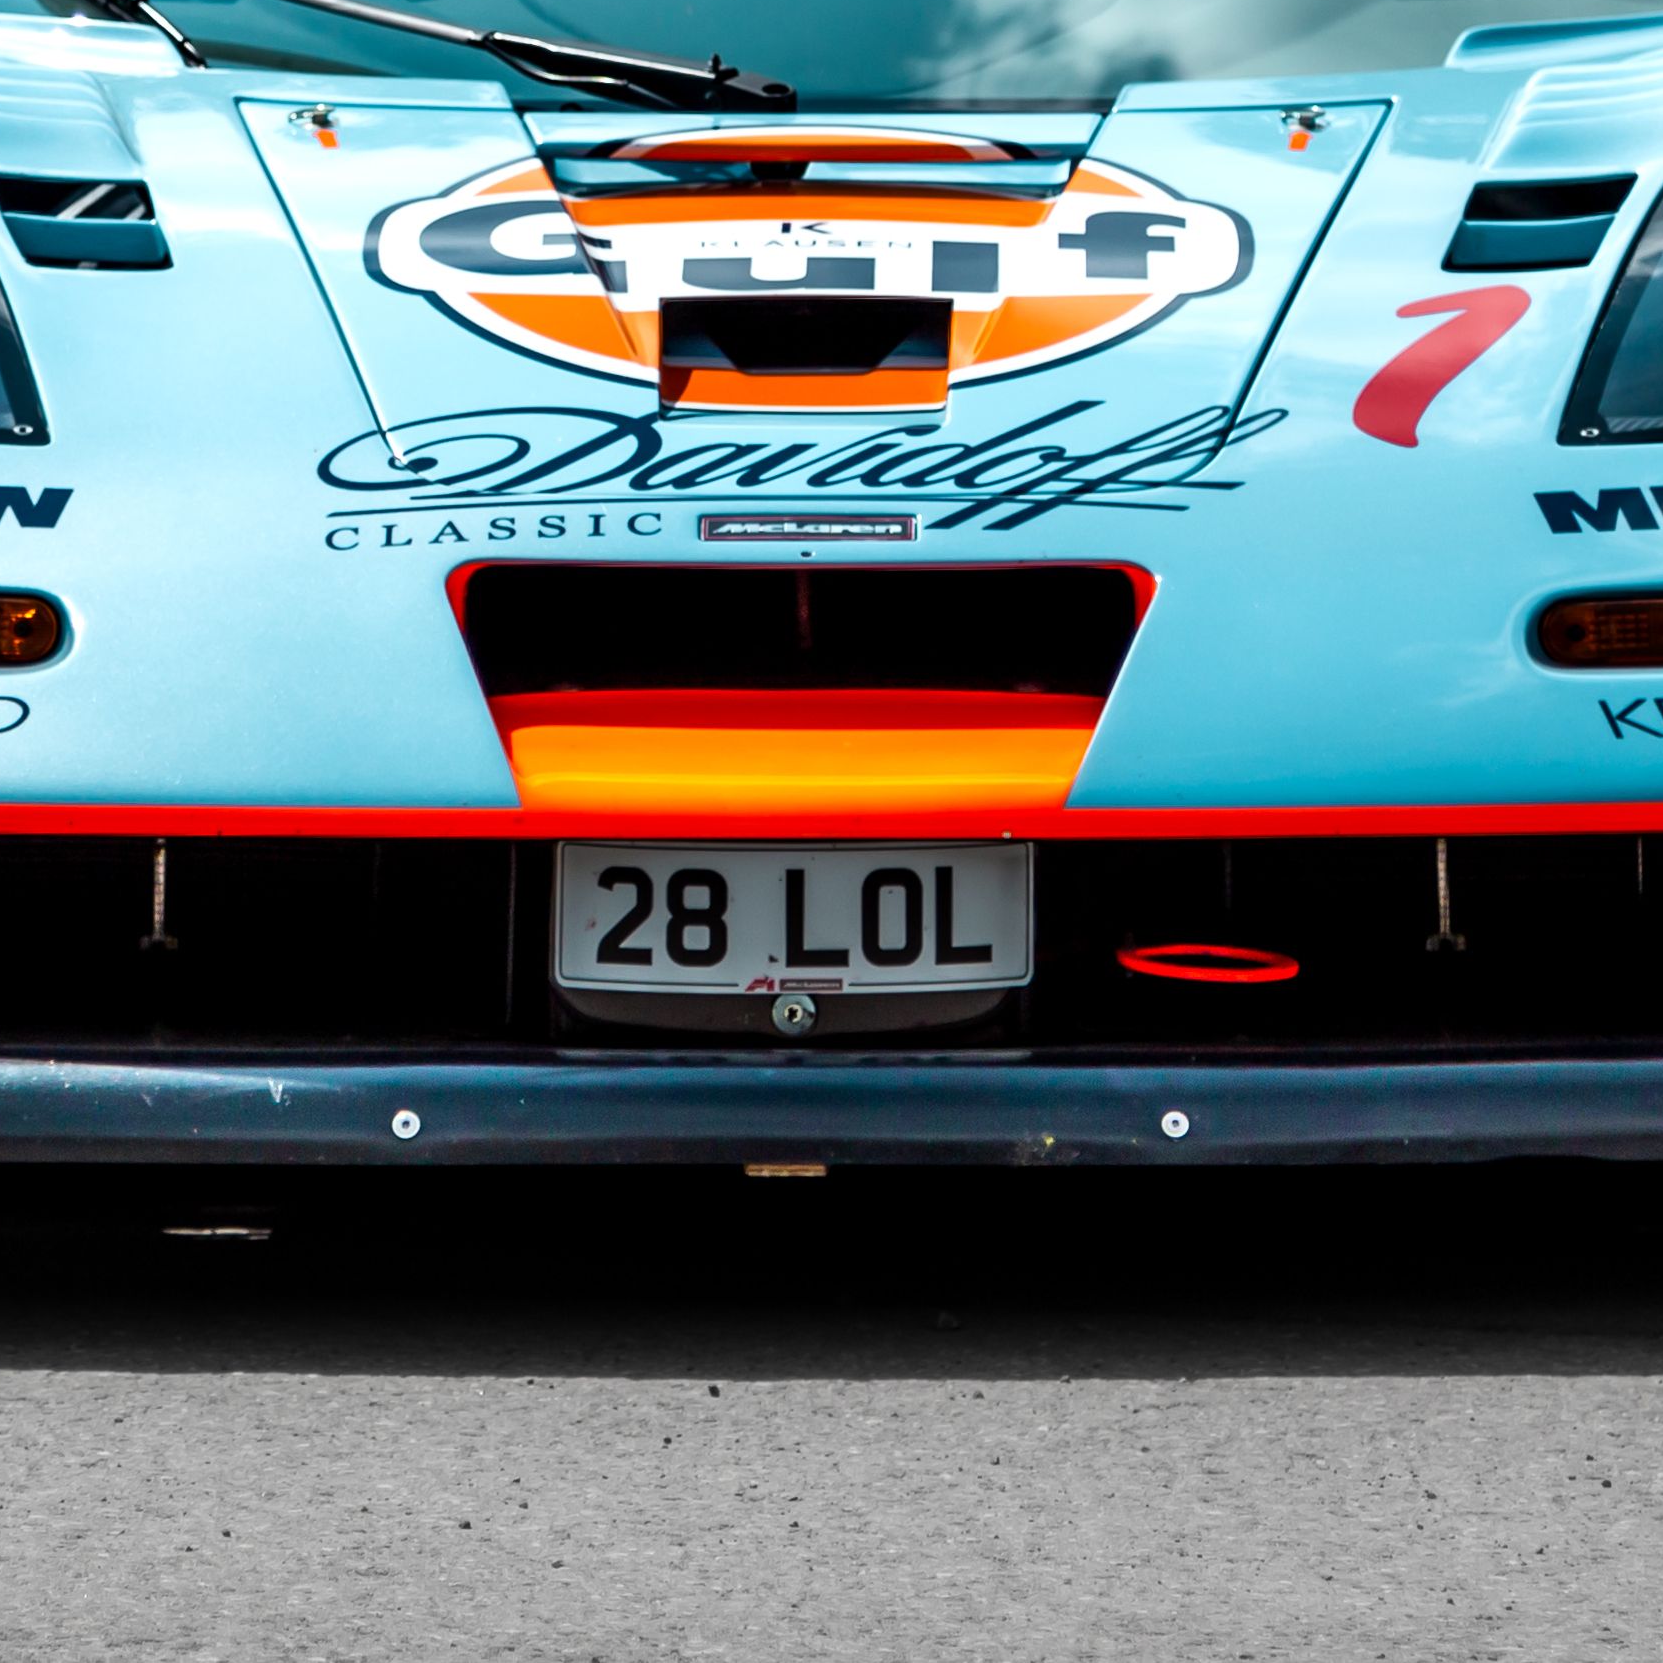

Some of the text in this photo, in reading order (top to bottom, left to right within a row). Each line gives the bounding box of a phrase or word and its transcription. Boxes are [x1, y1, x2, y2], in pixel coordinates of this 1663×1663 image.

[419, 199, 1186, 292] Gulf
[317, 400, 1289, 530] Davidoff
[324, 511, 663, 551] CLASSIC
[596, 865, 993, 968] 28 LOL
